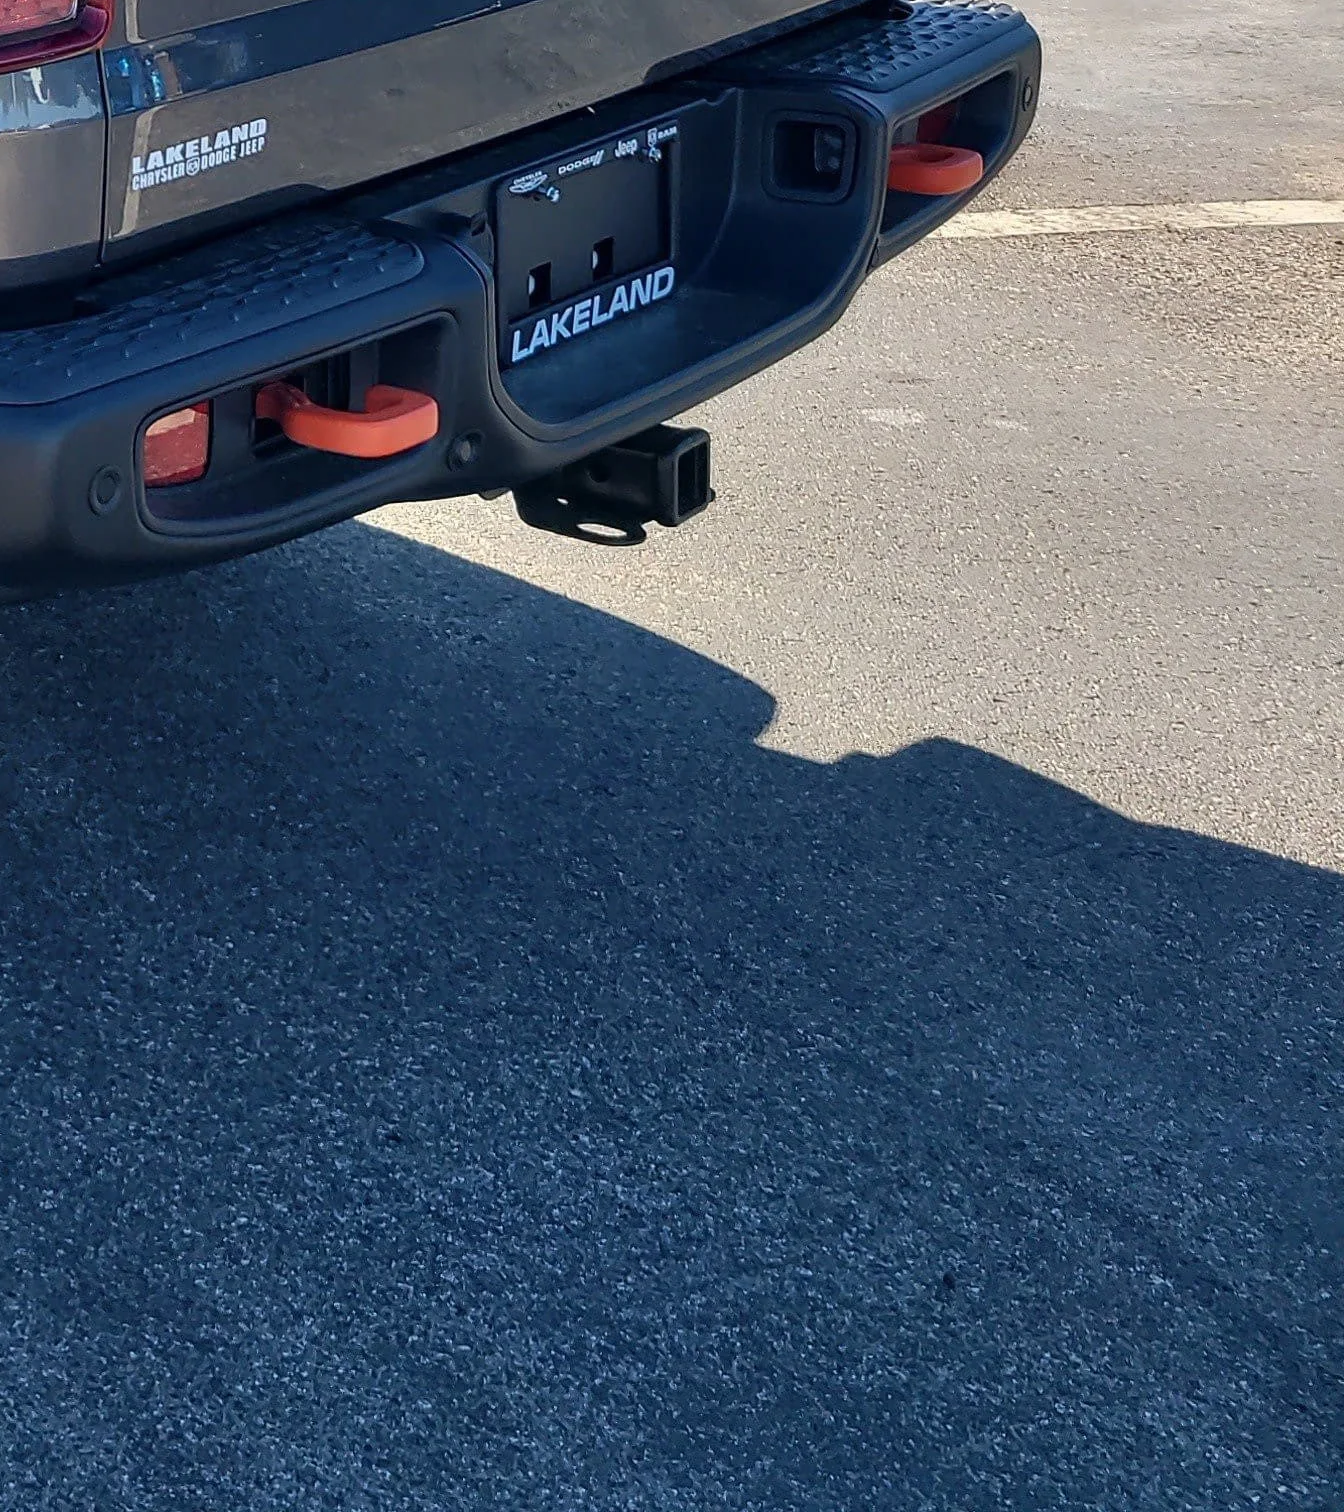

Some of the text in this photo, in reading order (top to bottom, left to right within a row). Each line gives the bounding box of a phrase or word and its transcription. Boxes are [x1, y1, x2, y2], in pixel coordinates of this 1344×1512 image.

[132, 118, 268, 175] LAKELAND
[132, 136, 266, 191] CHRYSLER DODGE JEEP
[558, 154, 598, 175] DODGE
[614, 138, 638, 158] Jeep
[657, 125, 678, 140] RAM
[511, 266, 676, 363] LAKELAND
